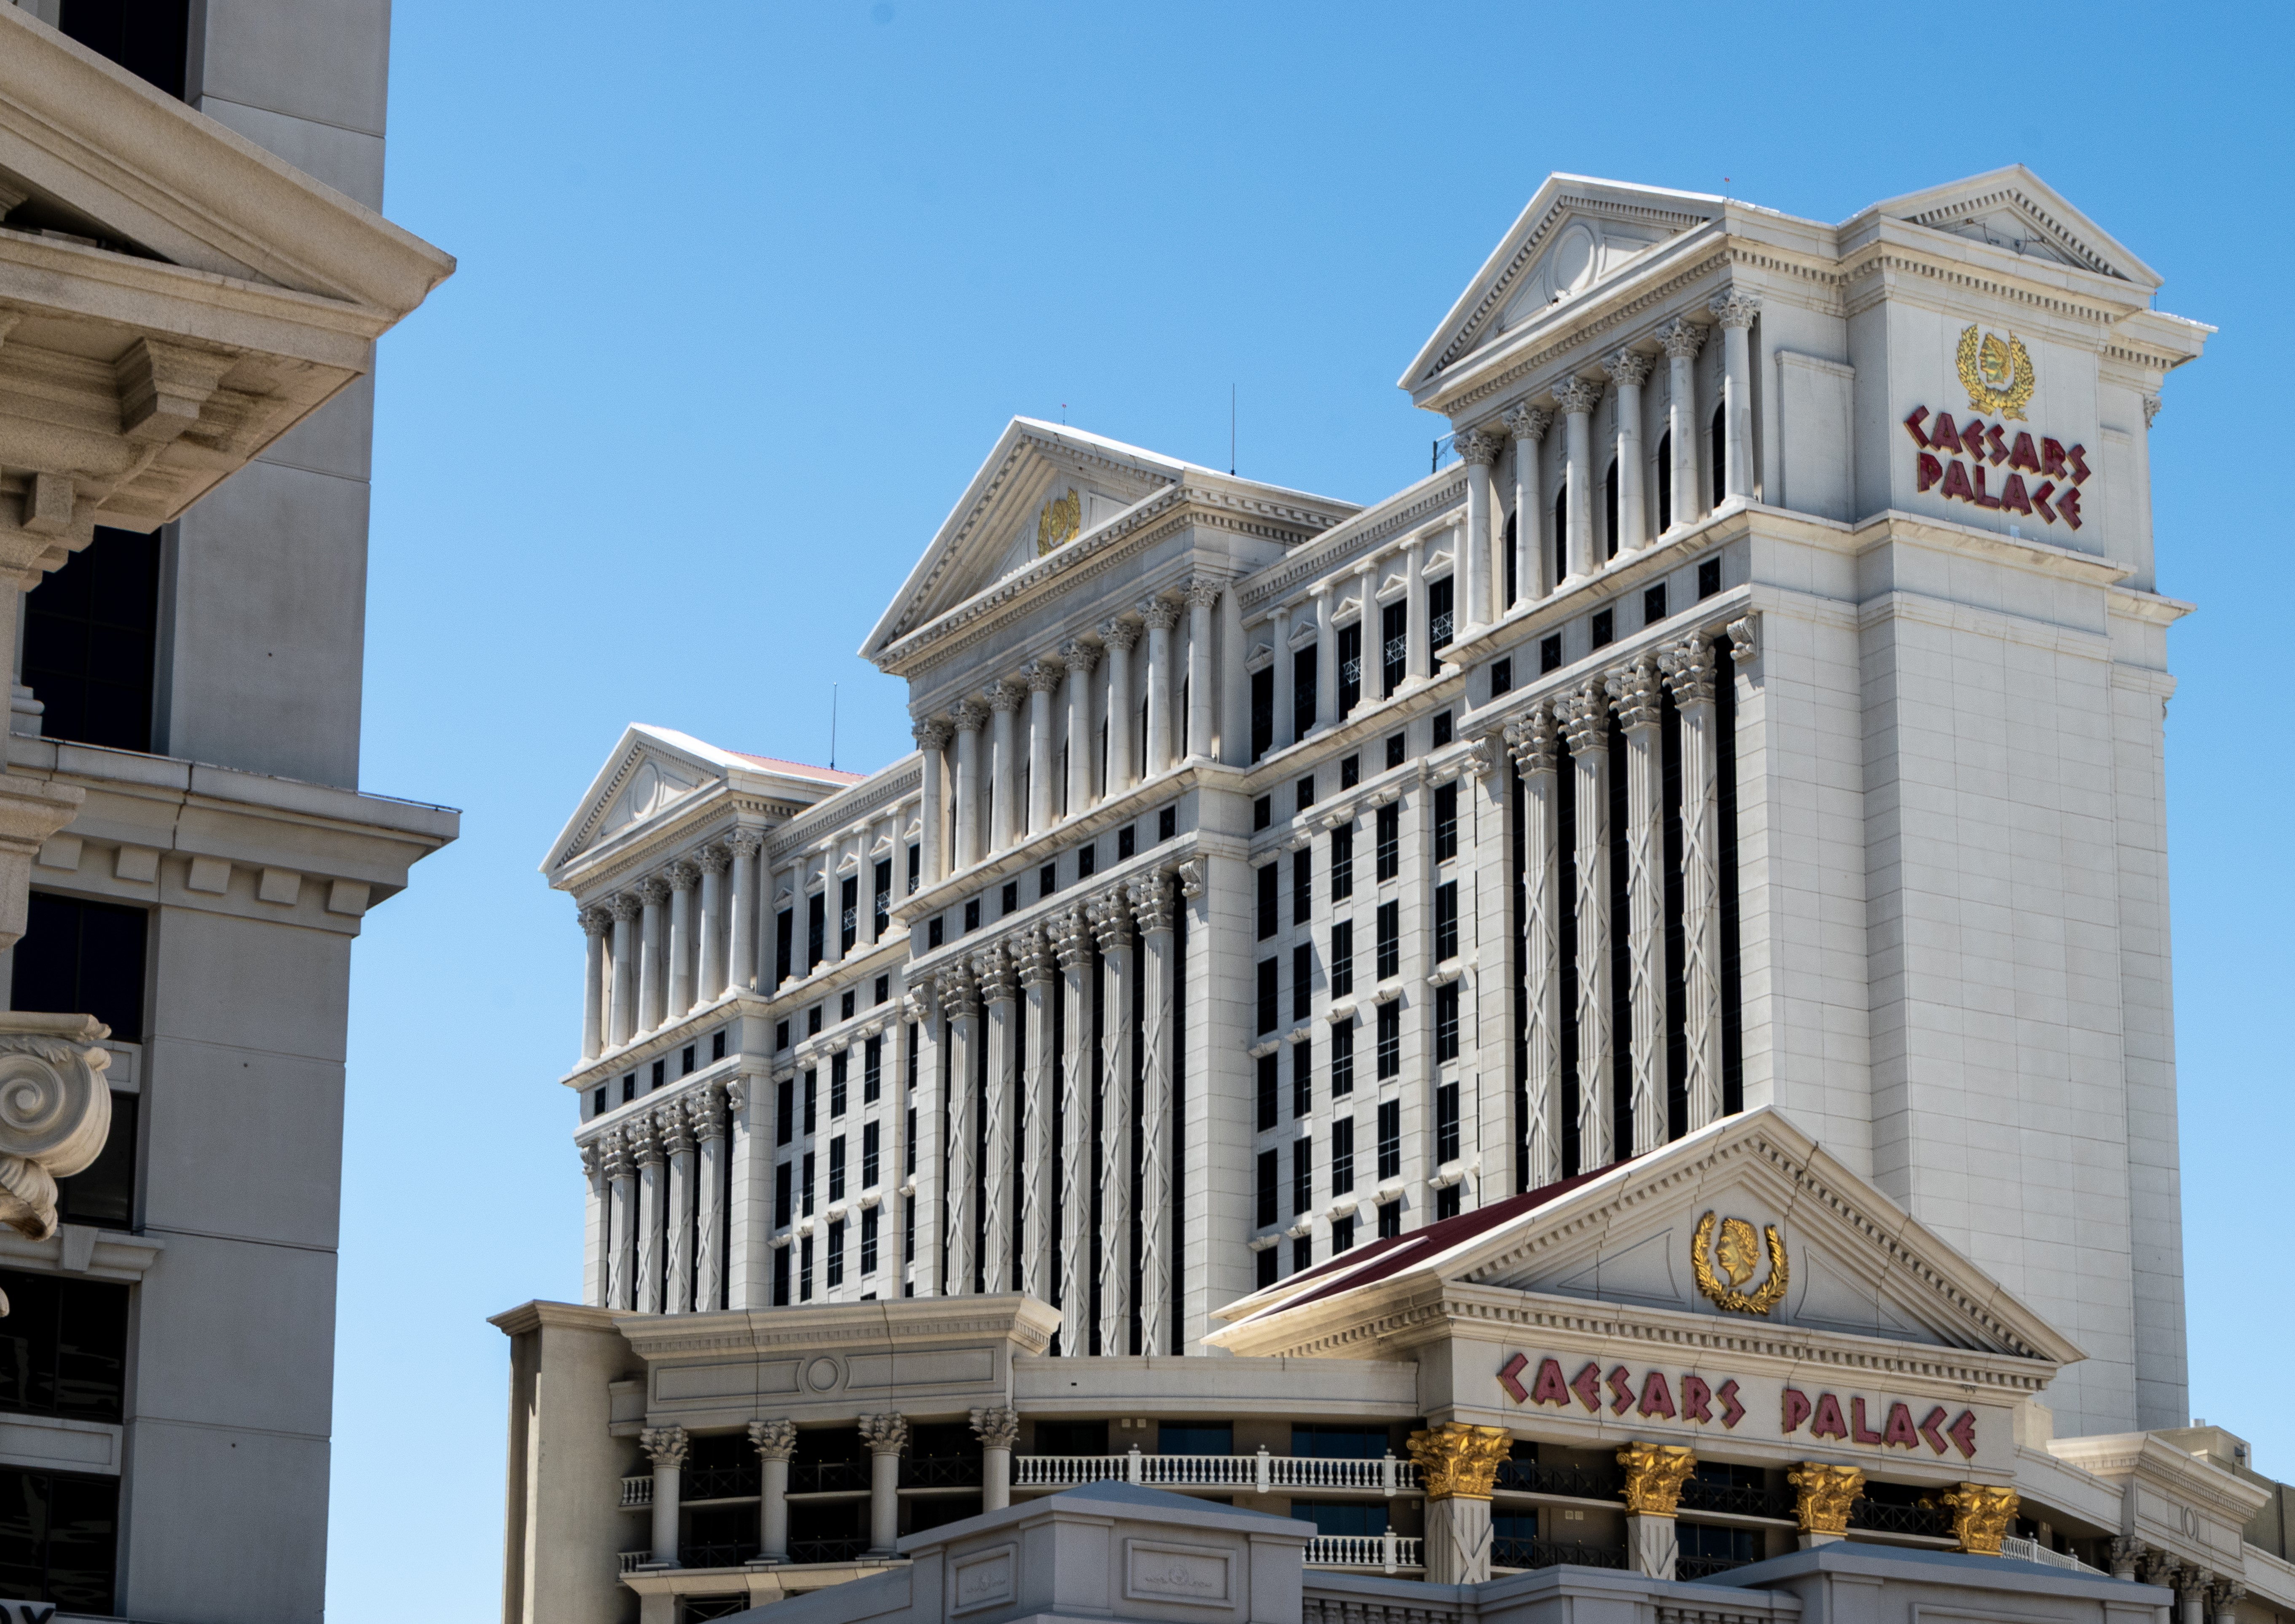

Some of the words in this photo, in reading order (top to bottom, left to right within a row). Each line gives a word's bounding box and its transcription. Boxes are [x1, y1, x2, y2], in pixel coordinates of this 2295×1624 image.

[1904, 405, 2091, 486] CAESARS
[1917, 452, 2082, 531] PALACE
[1497, 1353, 1746, 1428] CAESARS
[1783, 1389, 1976, 1459] PALACE
